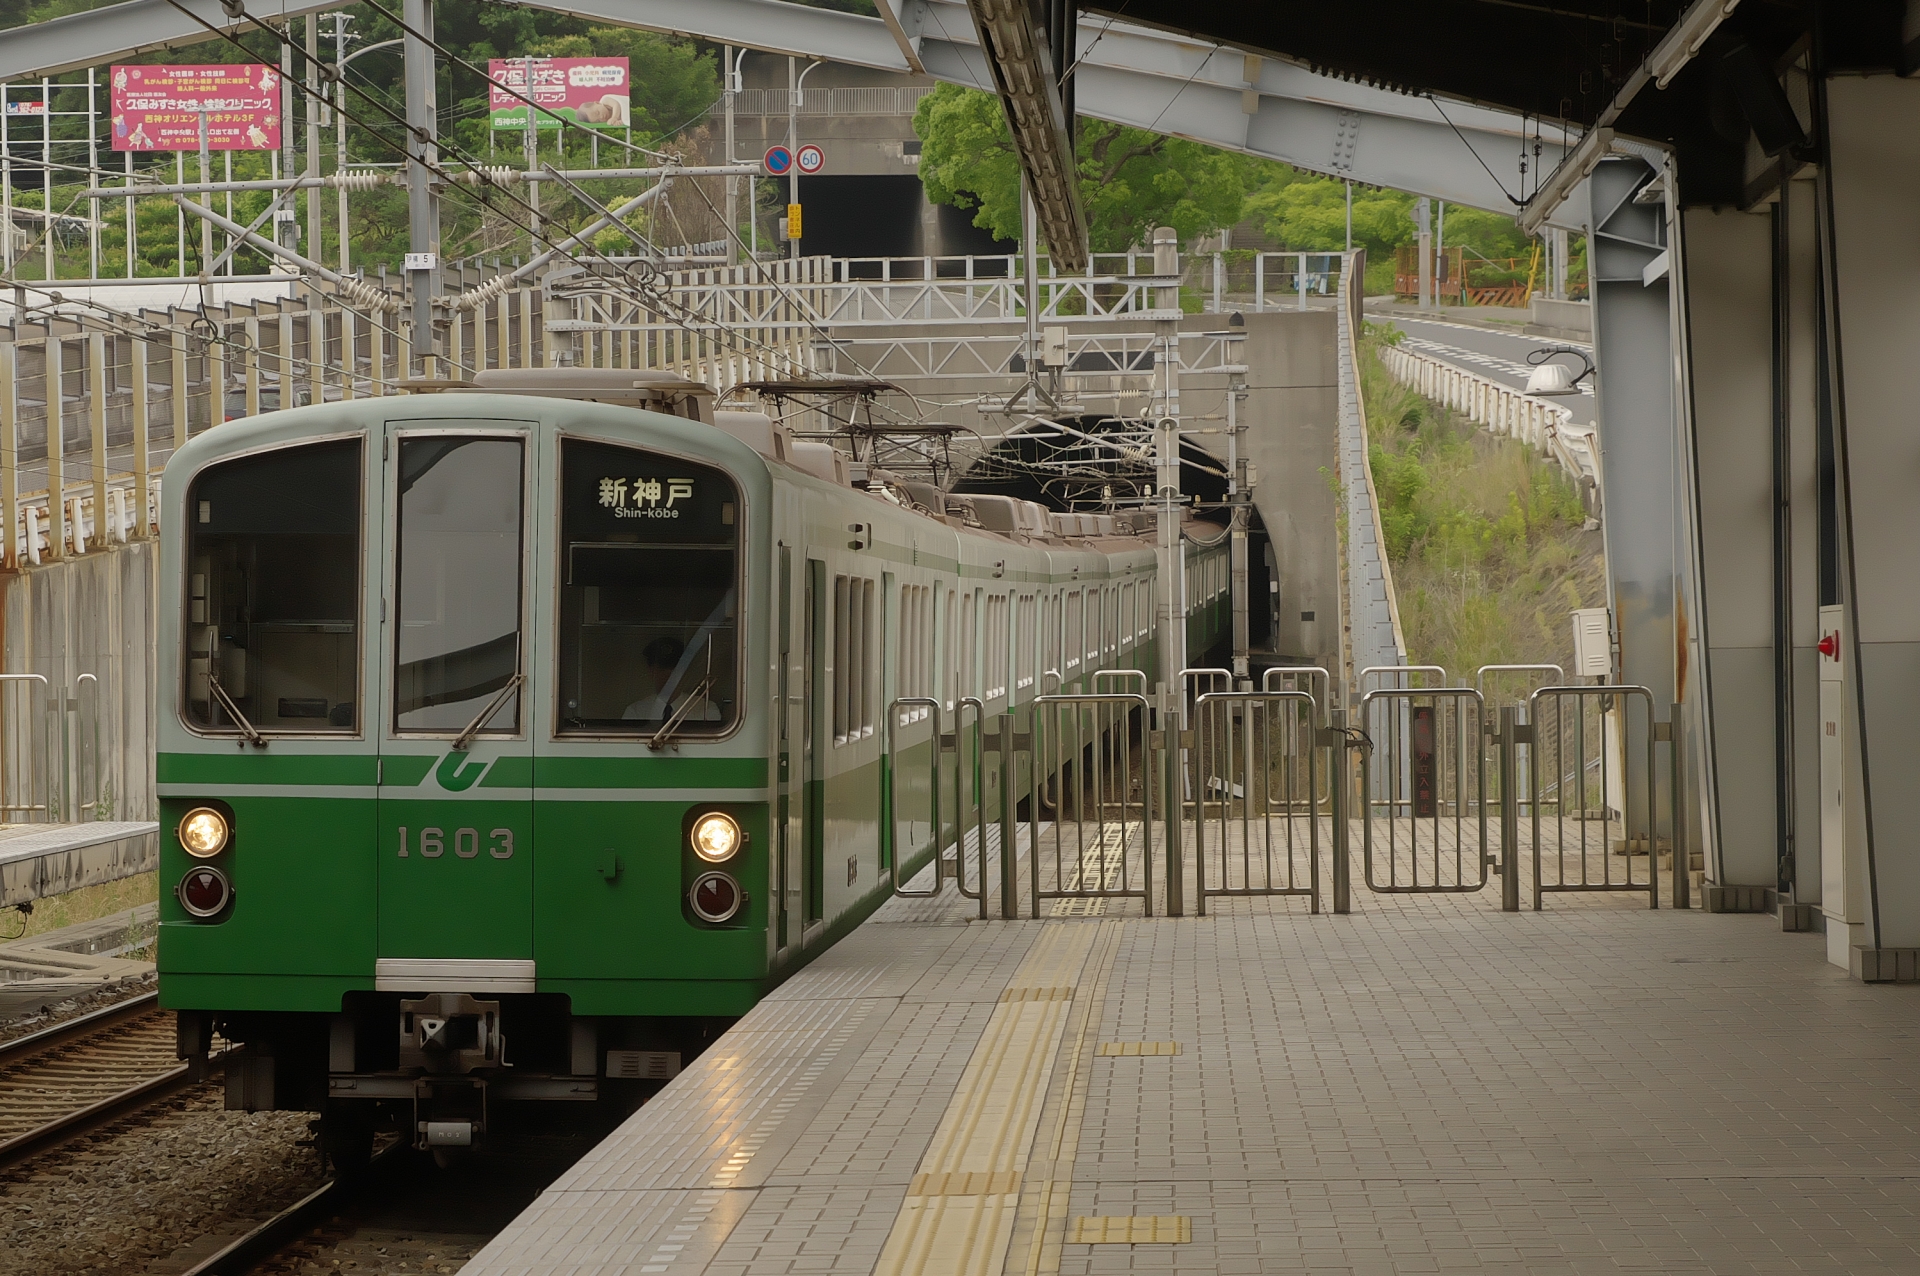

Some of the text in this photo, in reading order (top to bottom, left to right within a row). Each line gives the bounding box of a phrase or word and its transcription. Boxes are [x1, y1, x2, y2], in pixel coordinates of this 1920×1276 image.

[144, 113, 255, 124] 西神オリエンルホテル3F
[803, 152, 818, 166] 60
[424, 254, 429, 263] 5
[598, 476, 695, 508] 新神戸
[397, 826, 515, 860] 1603
